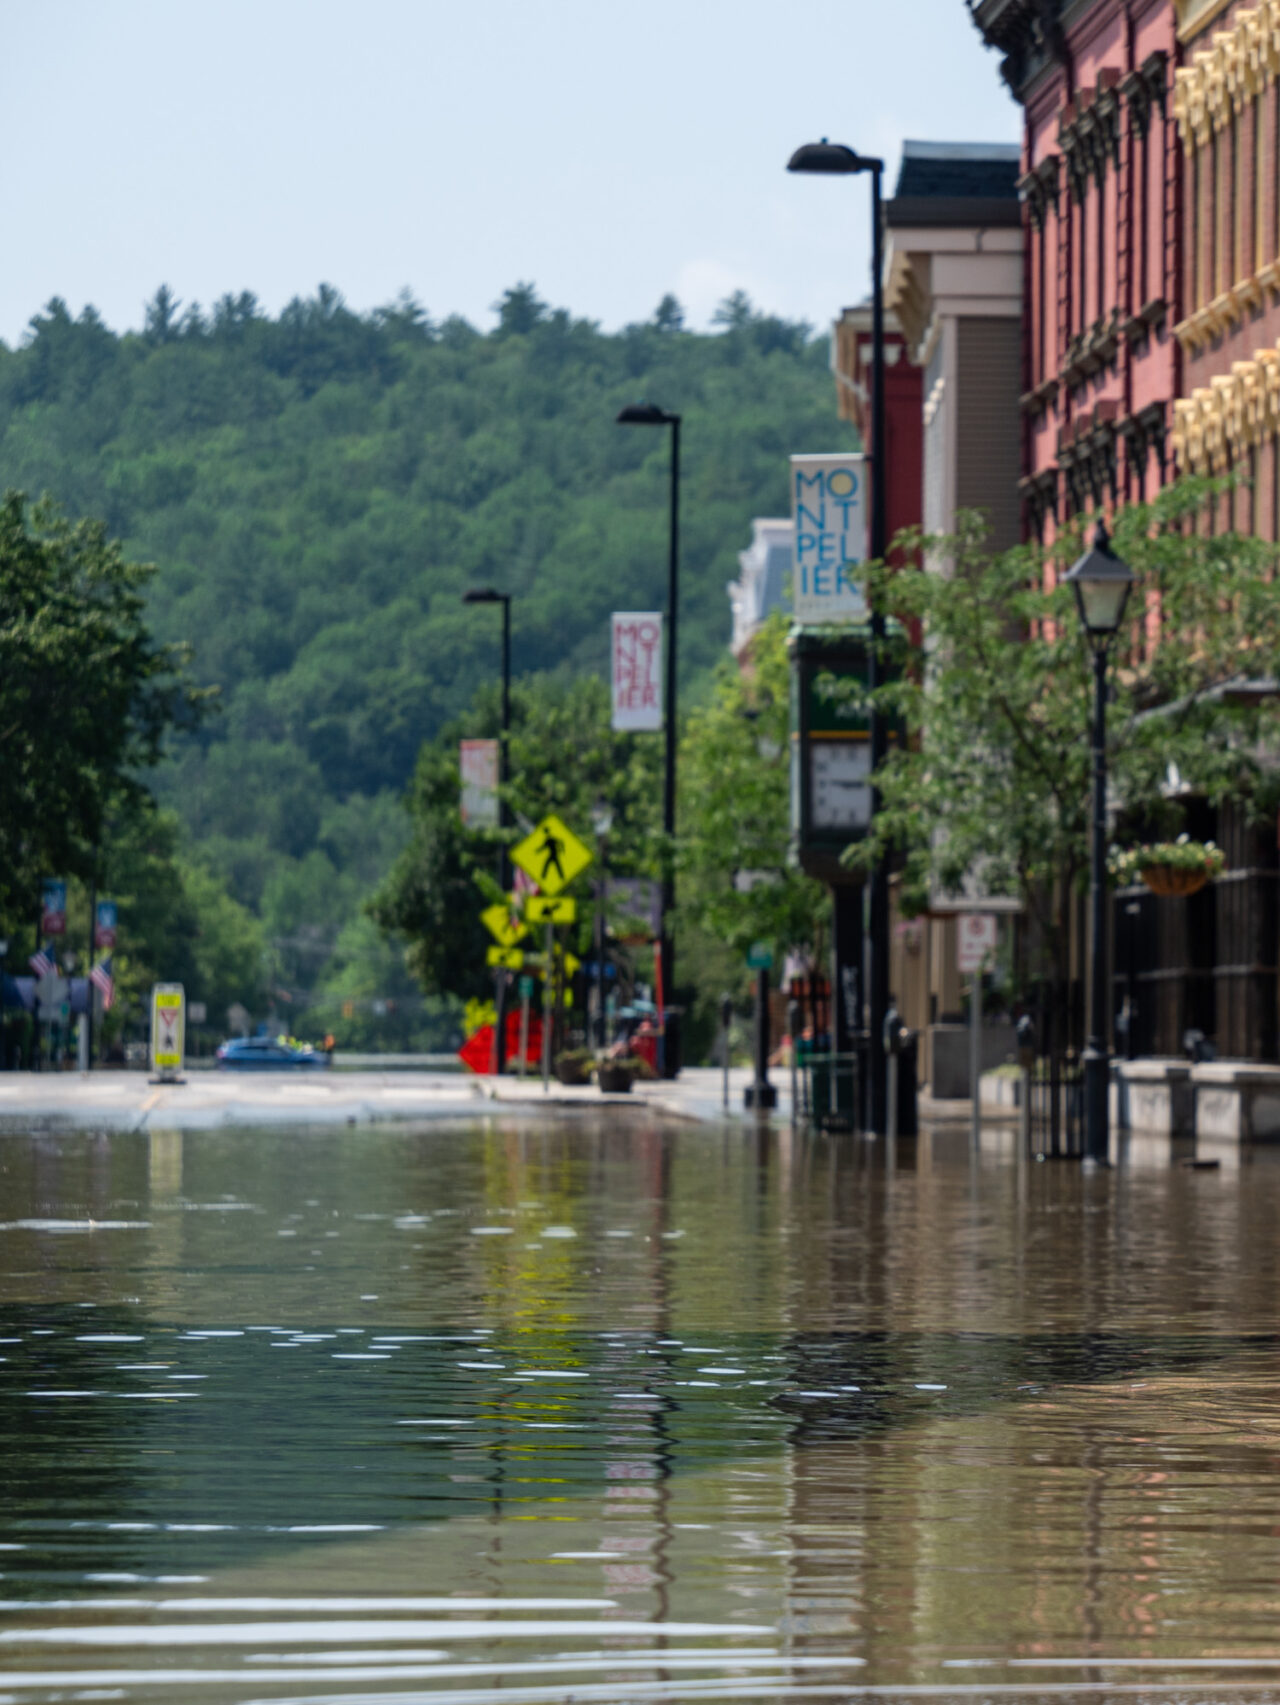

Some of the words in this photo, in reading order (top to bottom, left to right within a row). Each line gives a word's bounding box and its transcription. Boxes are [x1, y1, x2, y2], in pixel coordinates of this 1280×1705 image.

[796, 468, 858, 499] MO
[797, 501, 858, 531] NT
[797, 533, 859, 563] PEL
[802, 564, 858, 595] IER
